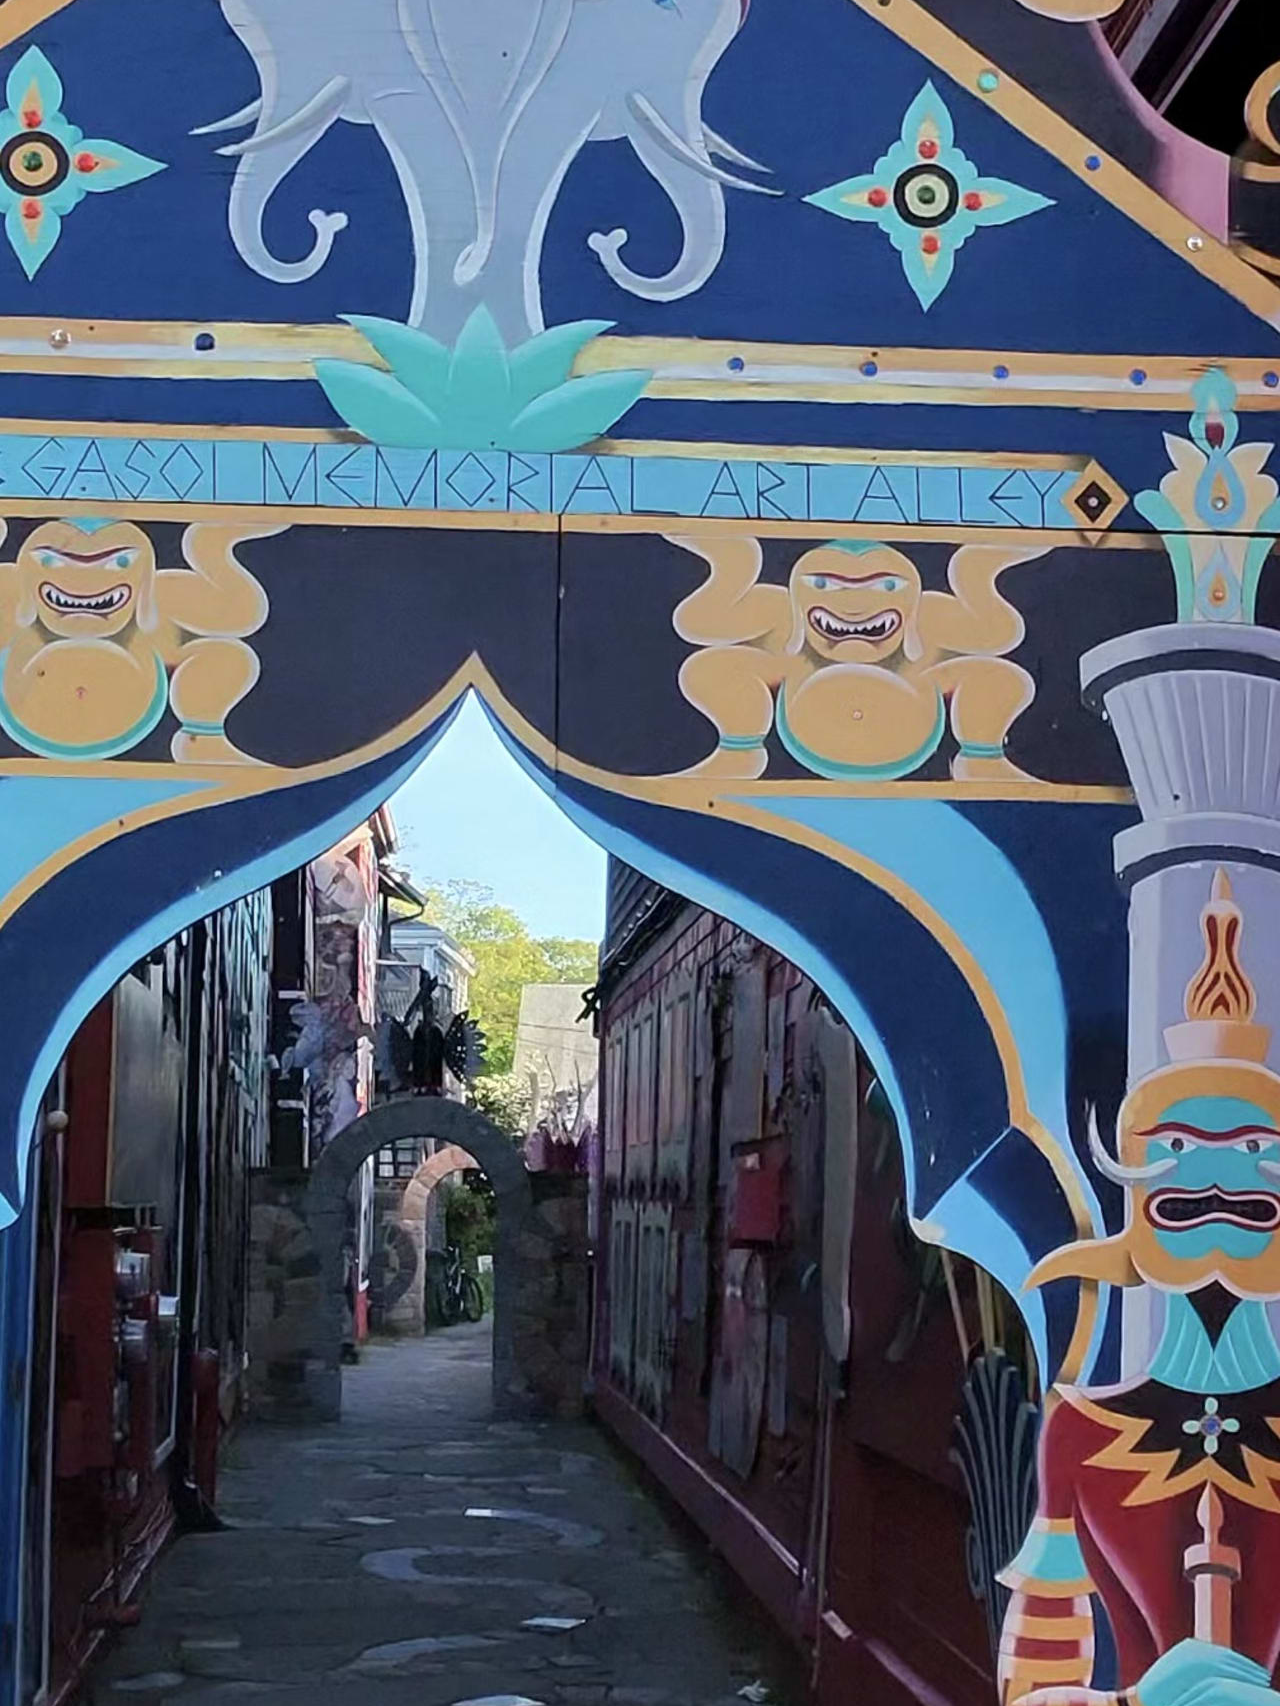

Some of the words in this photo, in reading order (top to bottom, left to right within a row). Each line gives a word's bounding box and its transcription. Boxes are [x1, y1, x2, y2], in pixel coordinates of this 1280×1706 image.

[21, 437, 217, 503] GASOI
[262, 442, 680, 515] MEMORIAL
[701, 461, 829, 520] ART
[853, 465, 1065, 530] ALLEY
